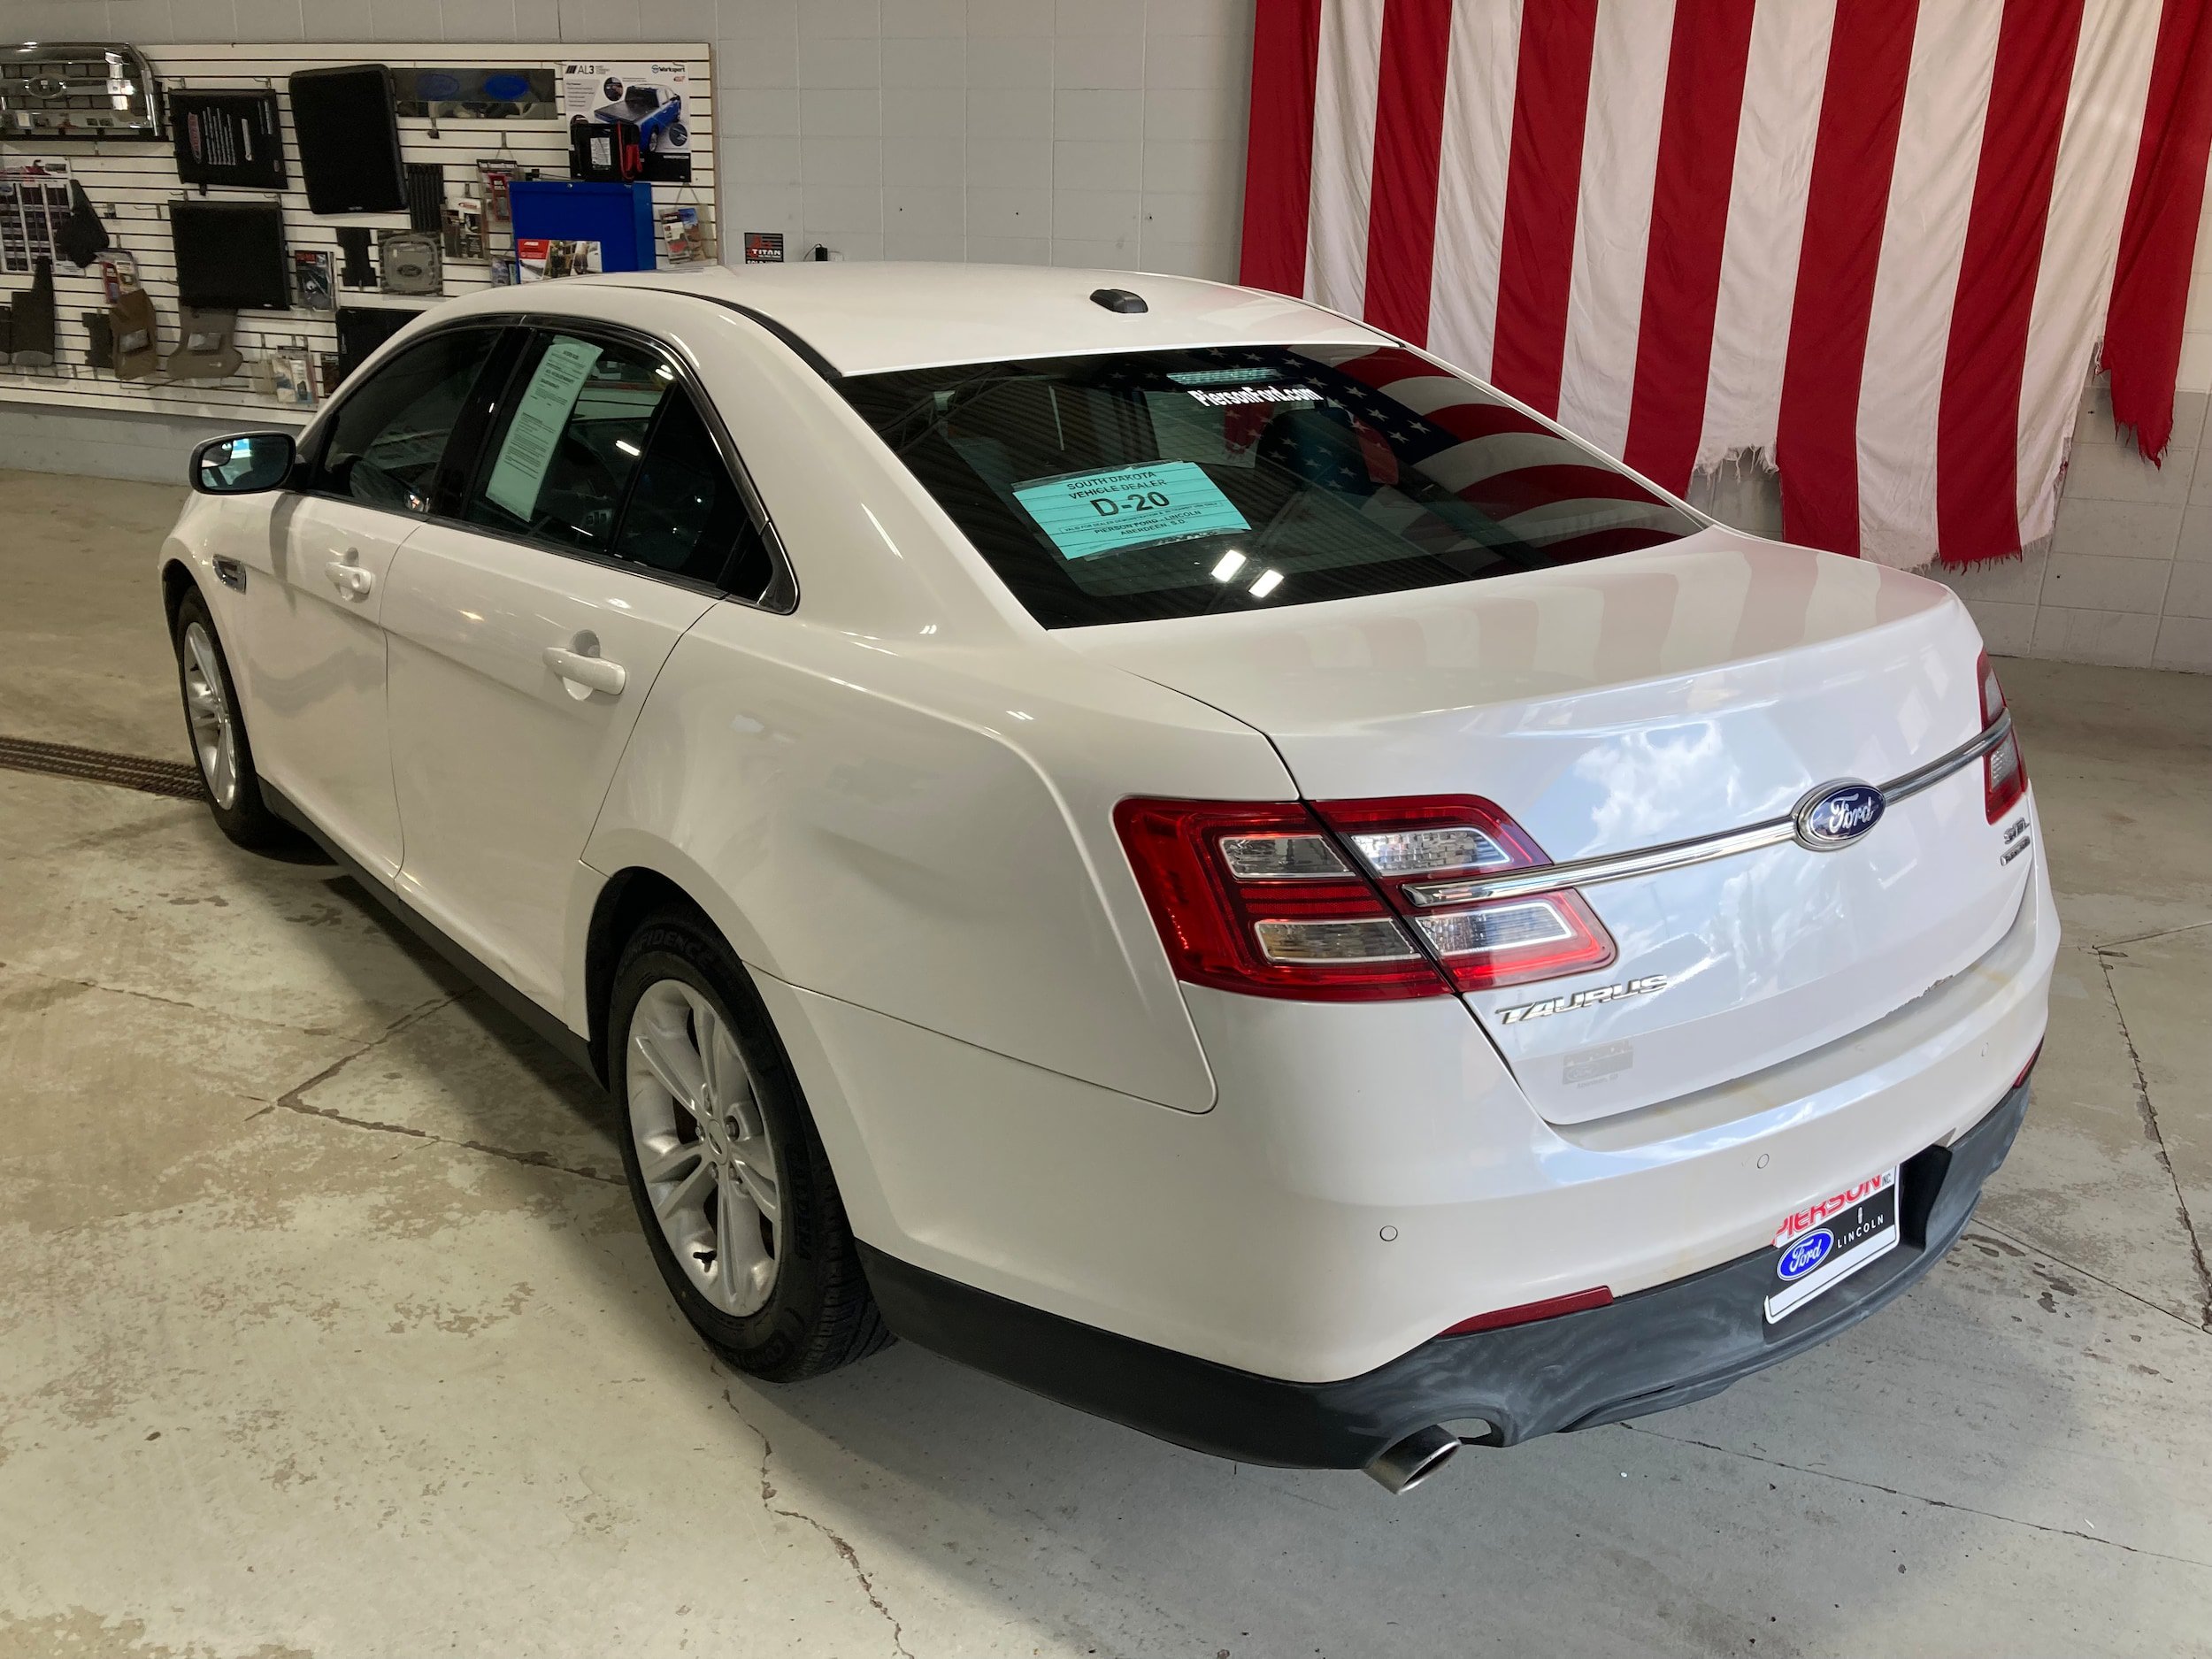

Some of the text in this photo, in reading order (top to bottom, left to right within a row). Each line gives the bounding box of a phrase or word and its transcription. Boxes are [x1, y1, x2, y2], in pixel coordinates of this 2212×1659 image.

[577, 65, 595, 74] AL3
[1187, 385, 1324, 407] PiersonFord.com
[1066, 471, 1156, 490] SOUTH DAKOTA
[1068, 479, 1167, 500] VEHICLE DEALER
[1090, 491, 1170, 517] D-20
[1094, 524, 1133, 534] PIERSON
[1133, 518, 1158, 528] FORD
[1164, 510, 1202, 521] LINCOLN
[1828, 793, 1876, 833] Ford
[1495, 974, 1668, 1025] TAURUS
[1788, 1214, 1884, 1273] Ford LINCOLN
